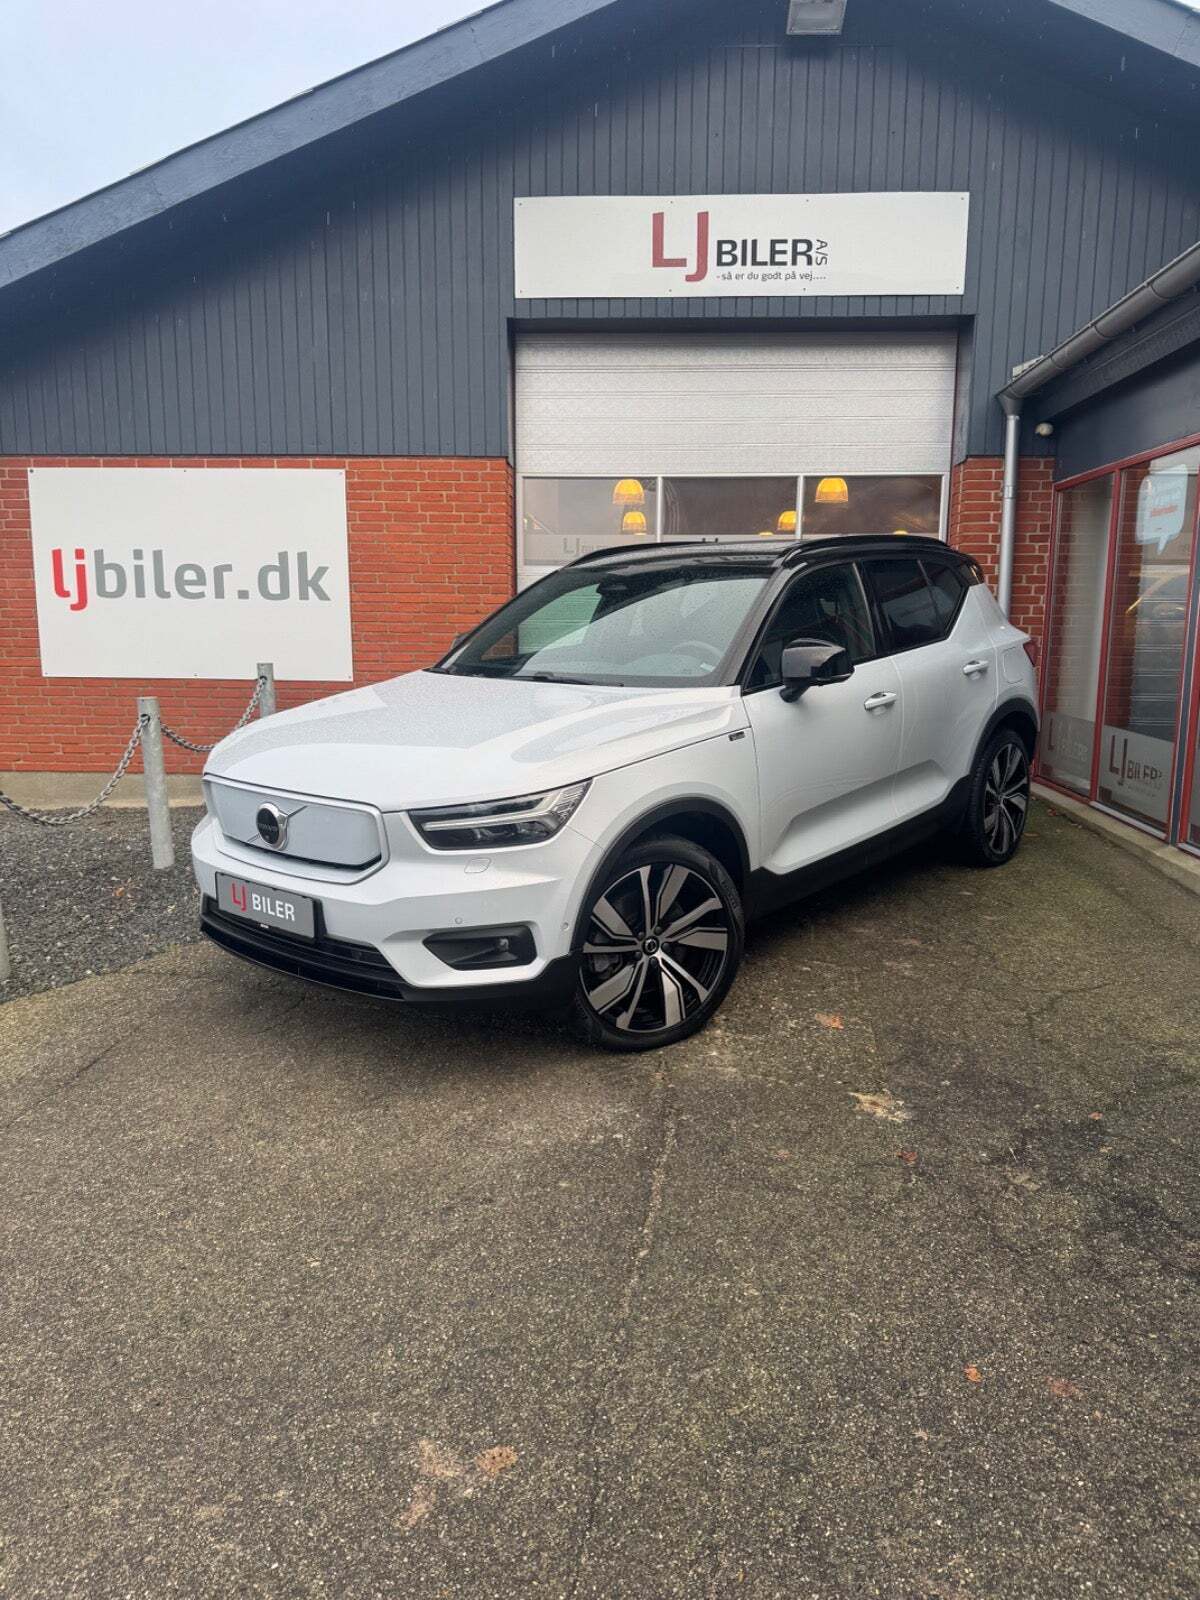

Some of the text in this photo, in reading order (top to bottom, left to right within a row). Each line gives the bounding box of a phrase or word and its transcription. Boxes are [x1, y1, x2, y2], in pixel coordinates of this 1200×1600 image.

[652, 211, 828, 282] LJ BILER A/S
[735, 272, 745, 280] er
[747, 270, 759, 280] du
[761, 271, 782, 282] godt
[784, 270, 797, 282] på
[51, 548, 331, 612] ljbiler.dk
[1109, 735, 1128, 786] LJ
[231, 882, 296, 922] LJ BILER
